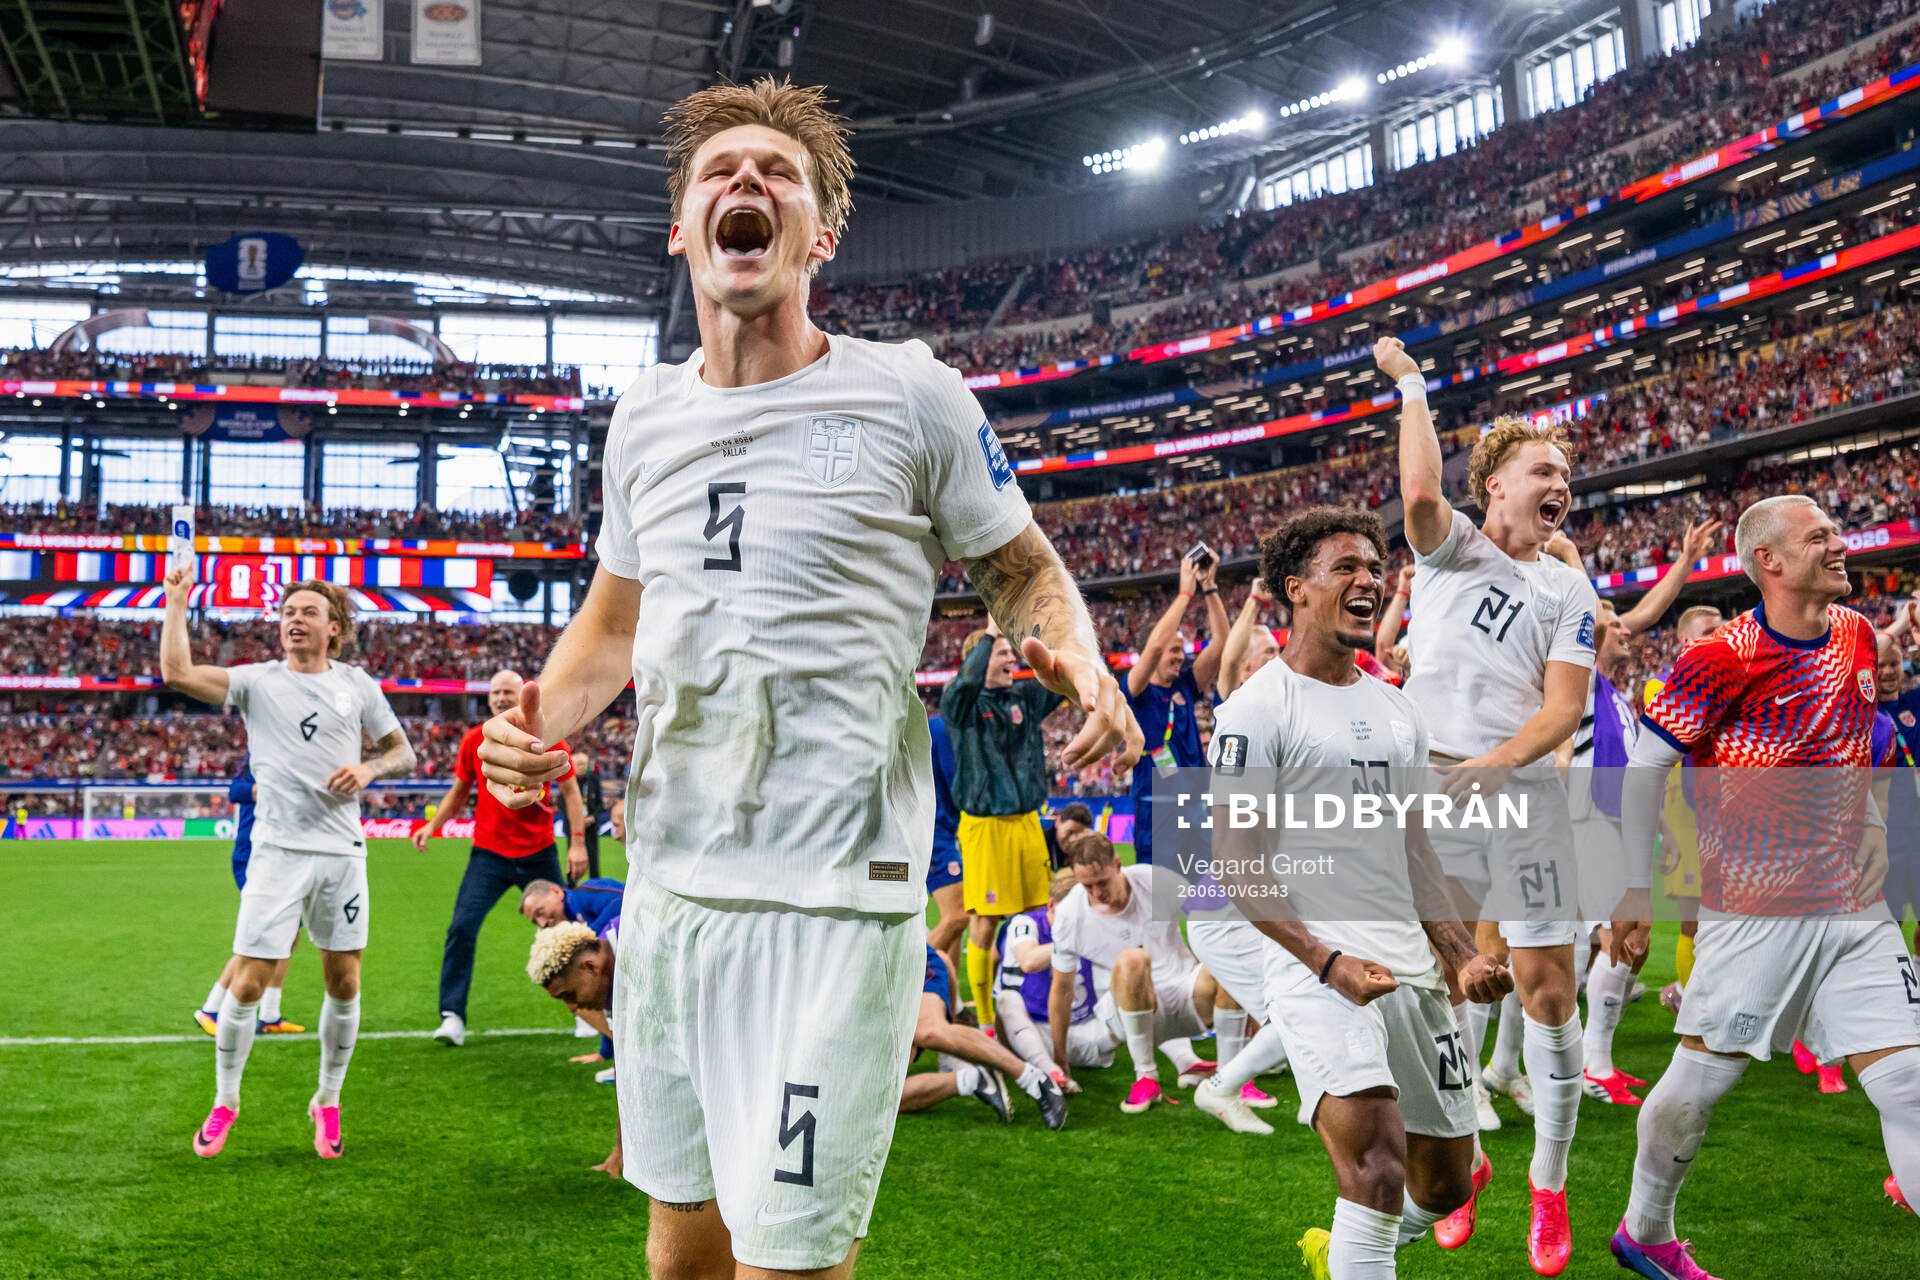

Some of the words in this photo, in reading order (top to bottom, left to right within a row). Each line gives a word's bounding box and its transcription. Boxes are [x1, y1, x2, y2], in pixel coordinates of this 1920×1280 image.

[723, 447, 747, 457] DALLAS
[1154, 441, 1176, 456] FIFA
[1175, 435, 1211, 452] WORLD
[1211, 431, 1231, 446] CUP
[1231, 425, 1265, 443] 2026
[703, 482, 746, 572] 5
[1470, 585, 1525, 643] 21
[300, 712, 318, 741] 6
[1519, 860, 1562, 909] 21
[343, 892, 361, 924] 6
[773, 1081, 820, 1188] 5
